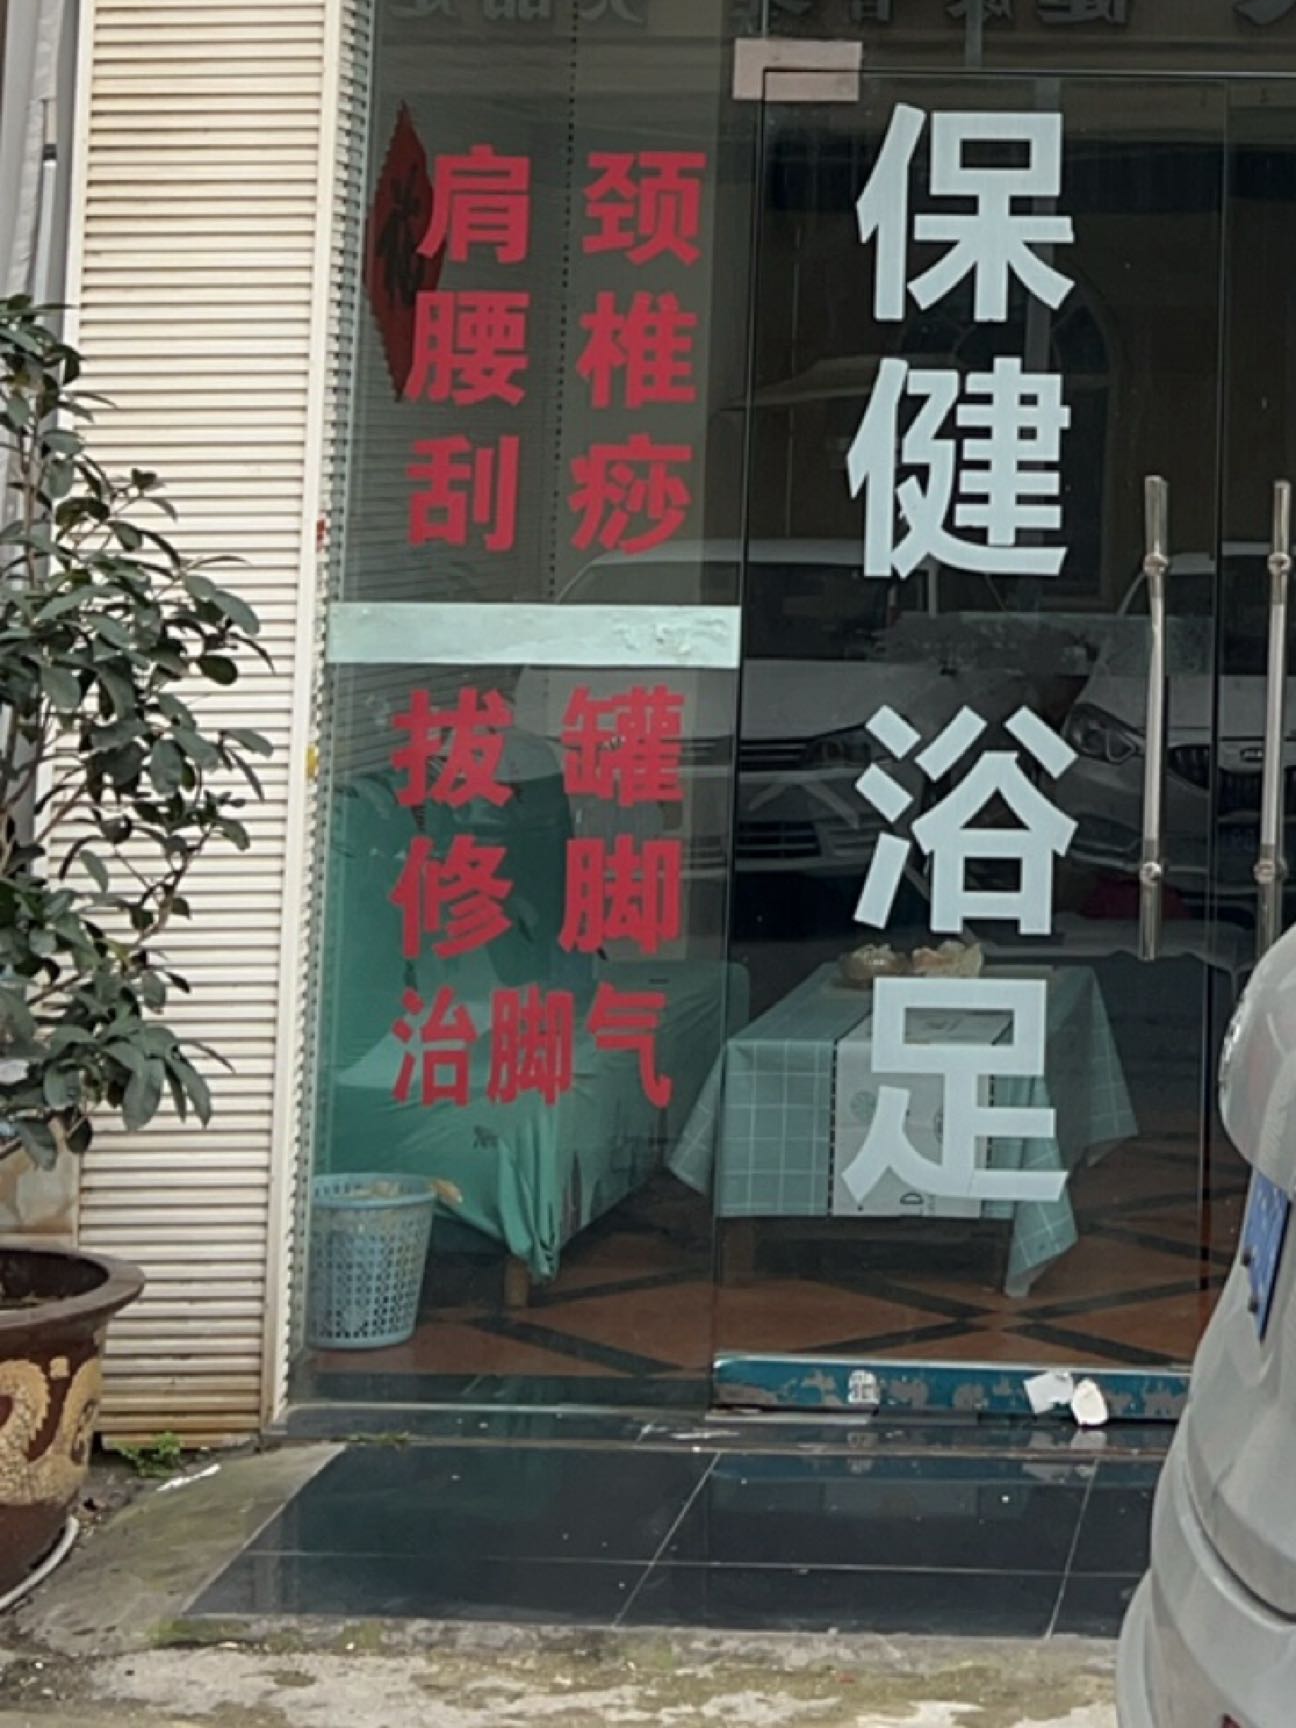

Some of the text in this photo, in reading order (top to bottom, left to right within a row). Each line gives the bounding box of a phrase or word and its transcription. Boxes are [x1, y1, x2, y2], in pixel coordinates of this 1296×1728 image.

[840, 102, 1079, 1205] 保健浴足
[392, 983, 672, 1107] 治脚气
